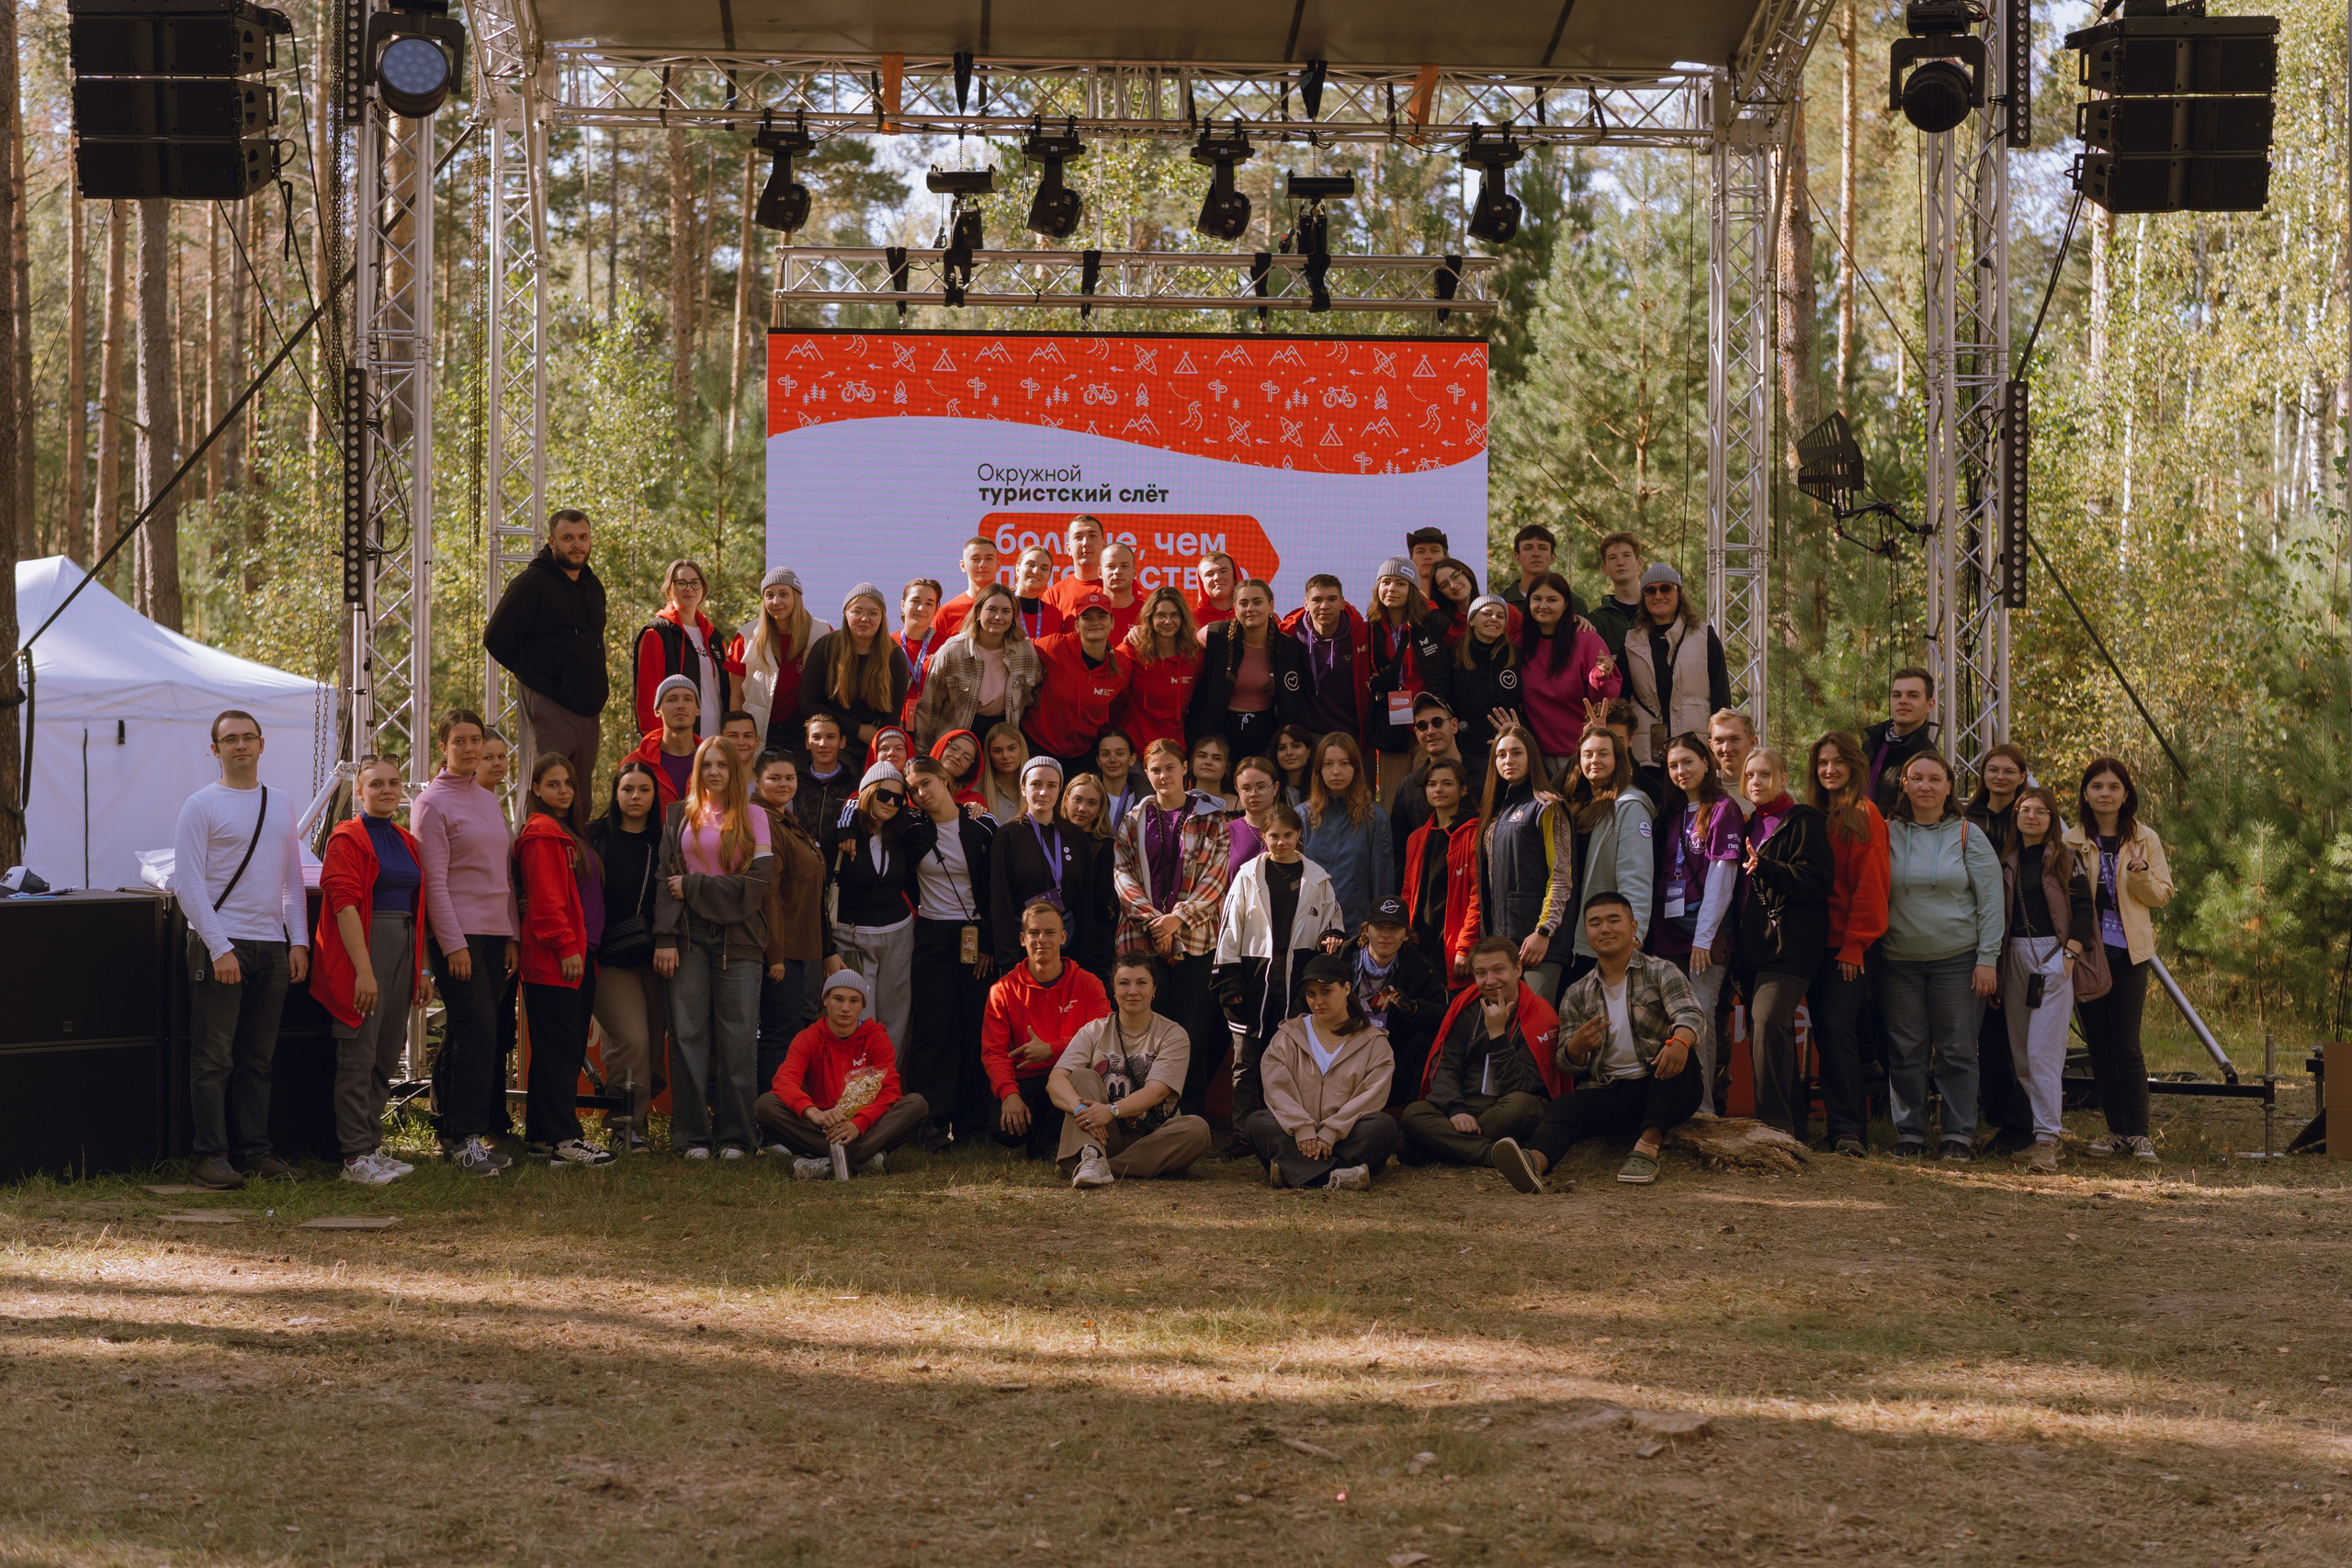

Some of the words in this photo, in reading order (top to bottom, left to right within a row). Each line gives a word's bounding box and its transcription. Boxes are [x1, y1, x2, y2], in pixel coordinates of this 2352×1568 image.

[978, 462, 1081, 487] Окружной
[978, 483, 1113, 506] туристский
[1119, 484, 1170, 503] слёт
[995, 523, 1147, 560] боле,
[1154, 532, 1227, 556] чем
